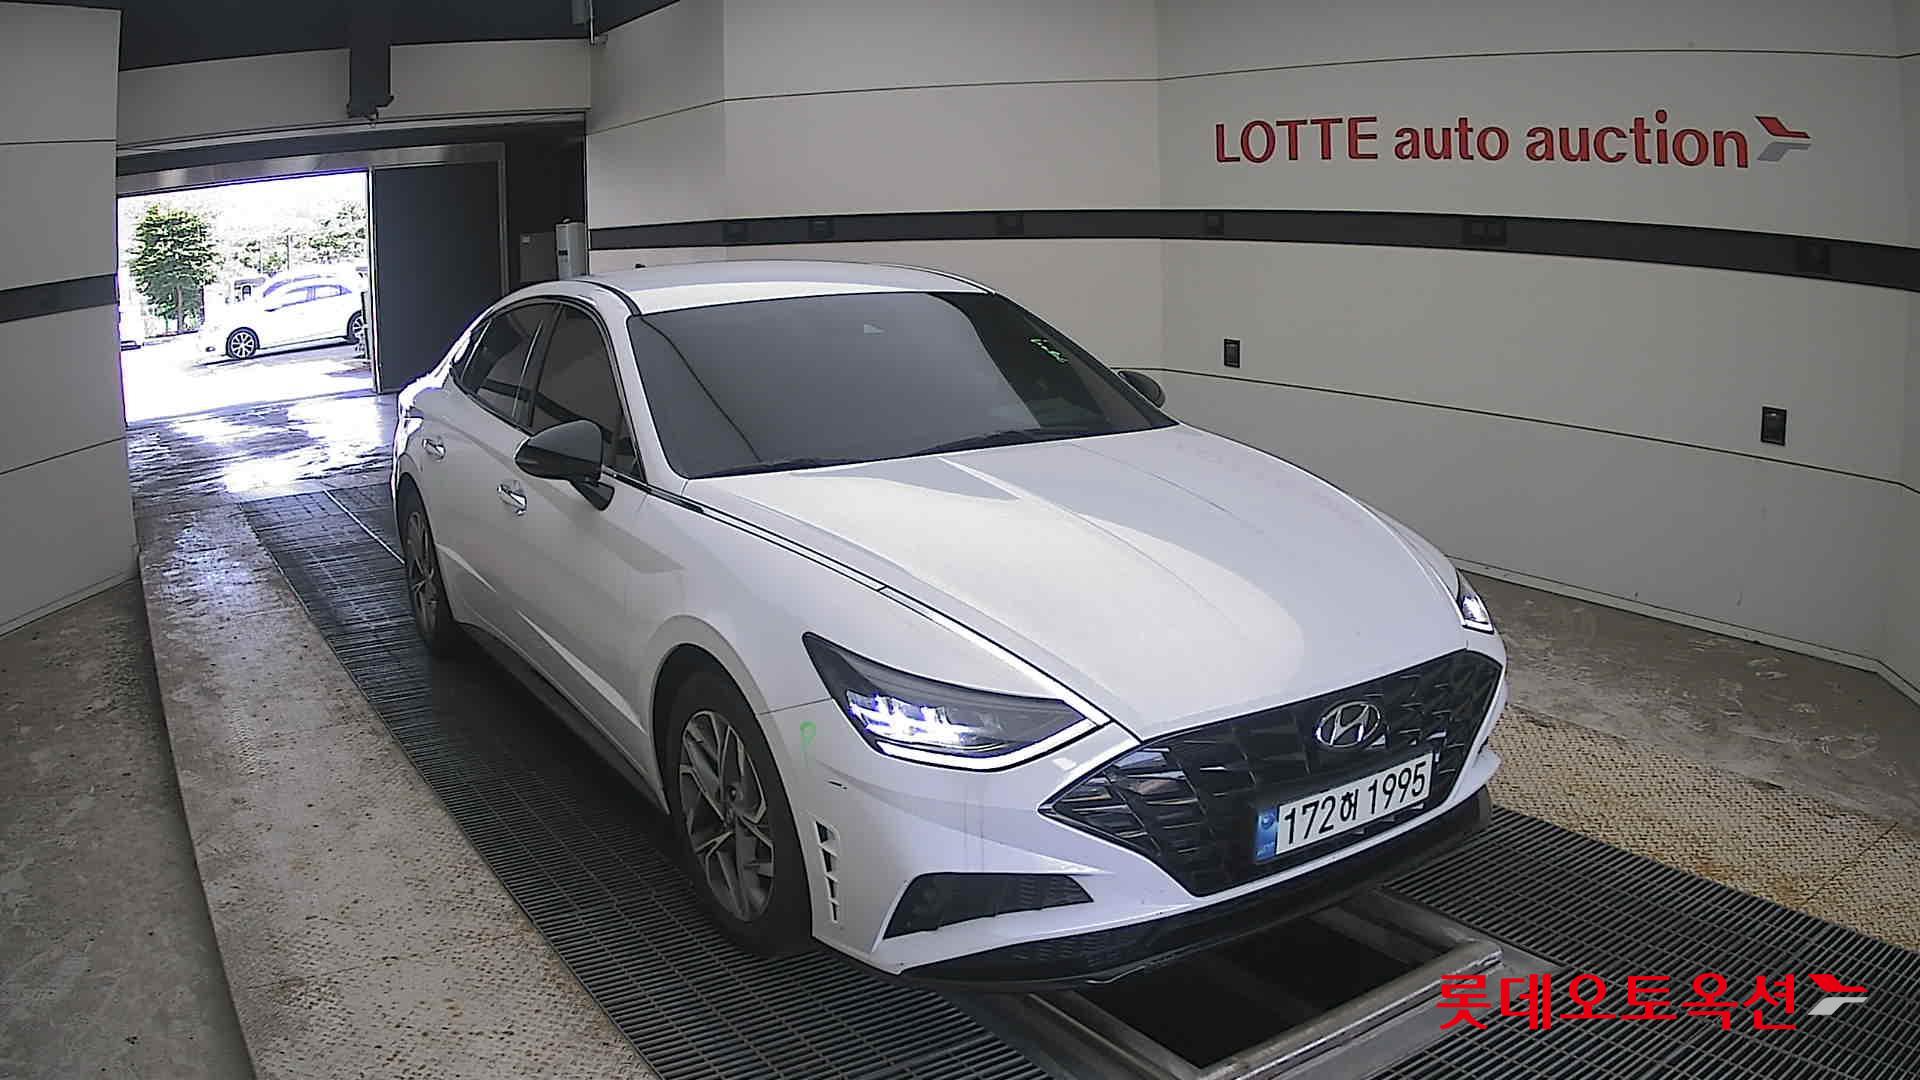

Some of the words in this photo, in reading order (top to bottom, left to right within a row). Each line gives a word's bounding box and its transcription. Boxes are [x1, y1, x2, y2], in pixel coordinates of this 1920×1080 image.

[1215, 116, 1378, 163] LOTTE
[1394, 117, 1510, 161] auto
[1526, 110, 1749, 169] auction
[1284, 789, 1360, 844] 172허
[1368, 761, 1427, 815] 1995
